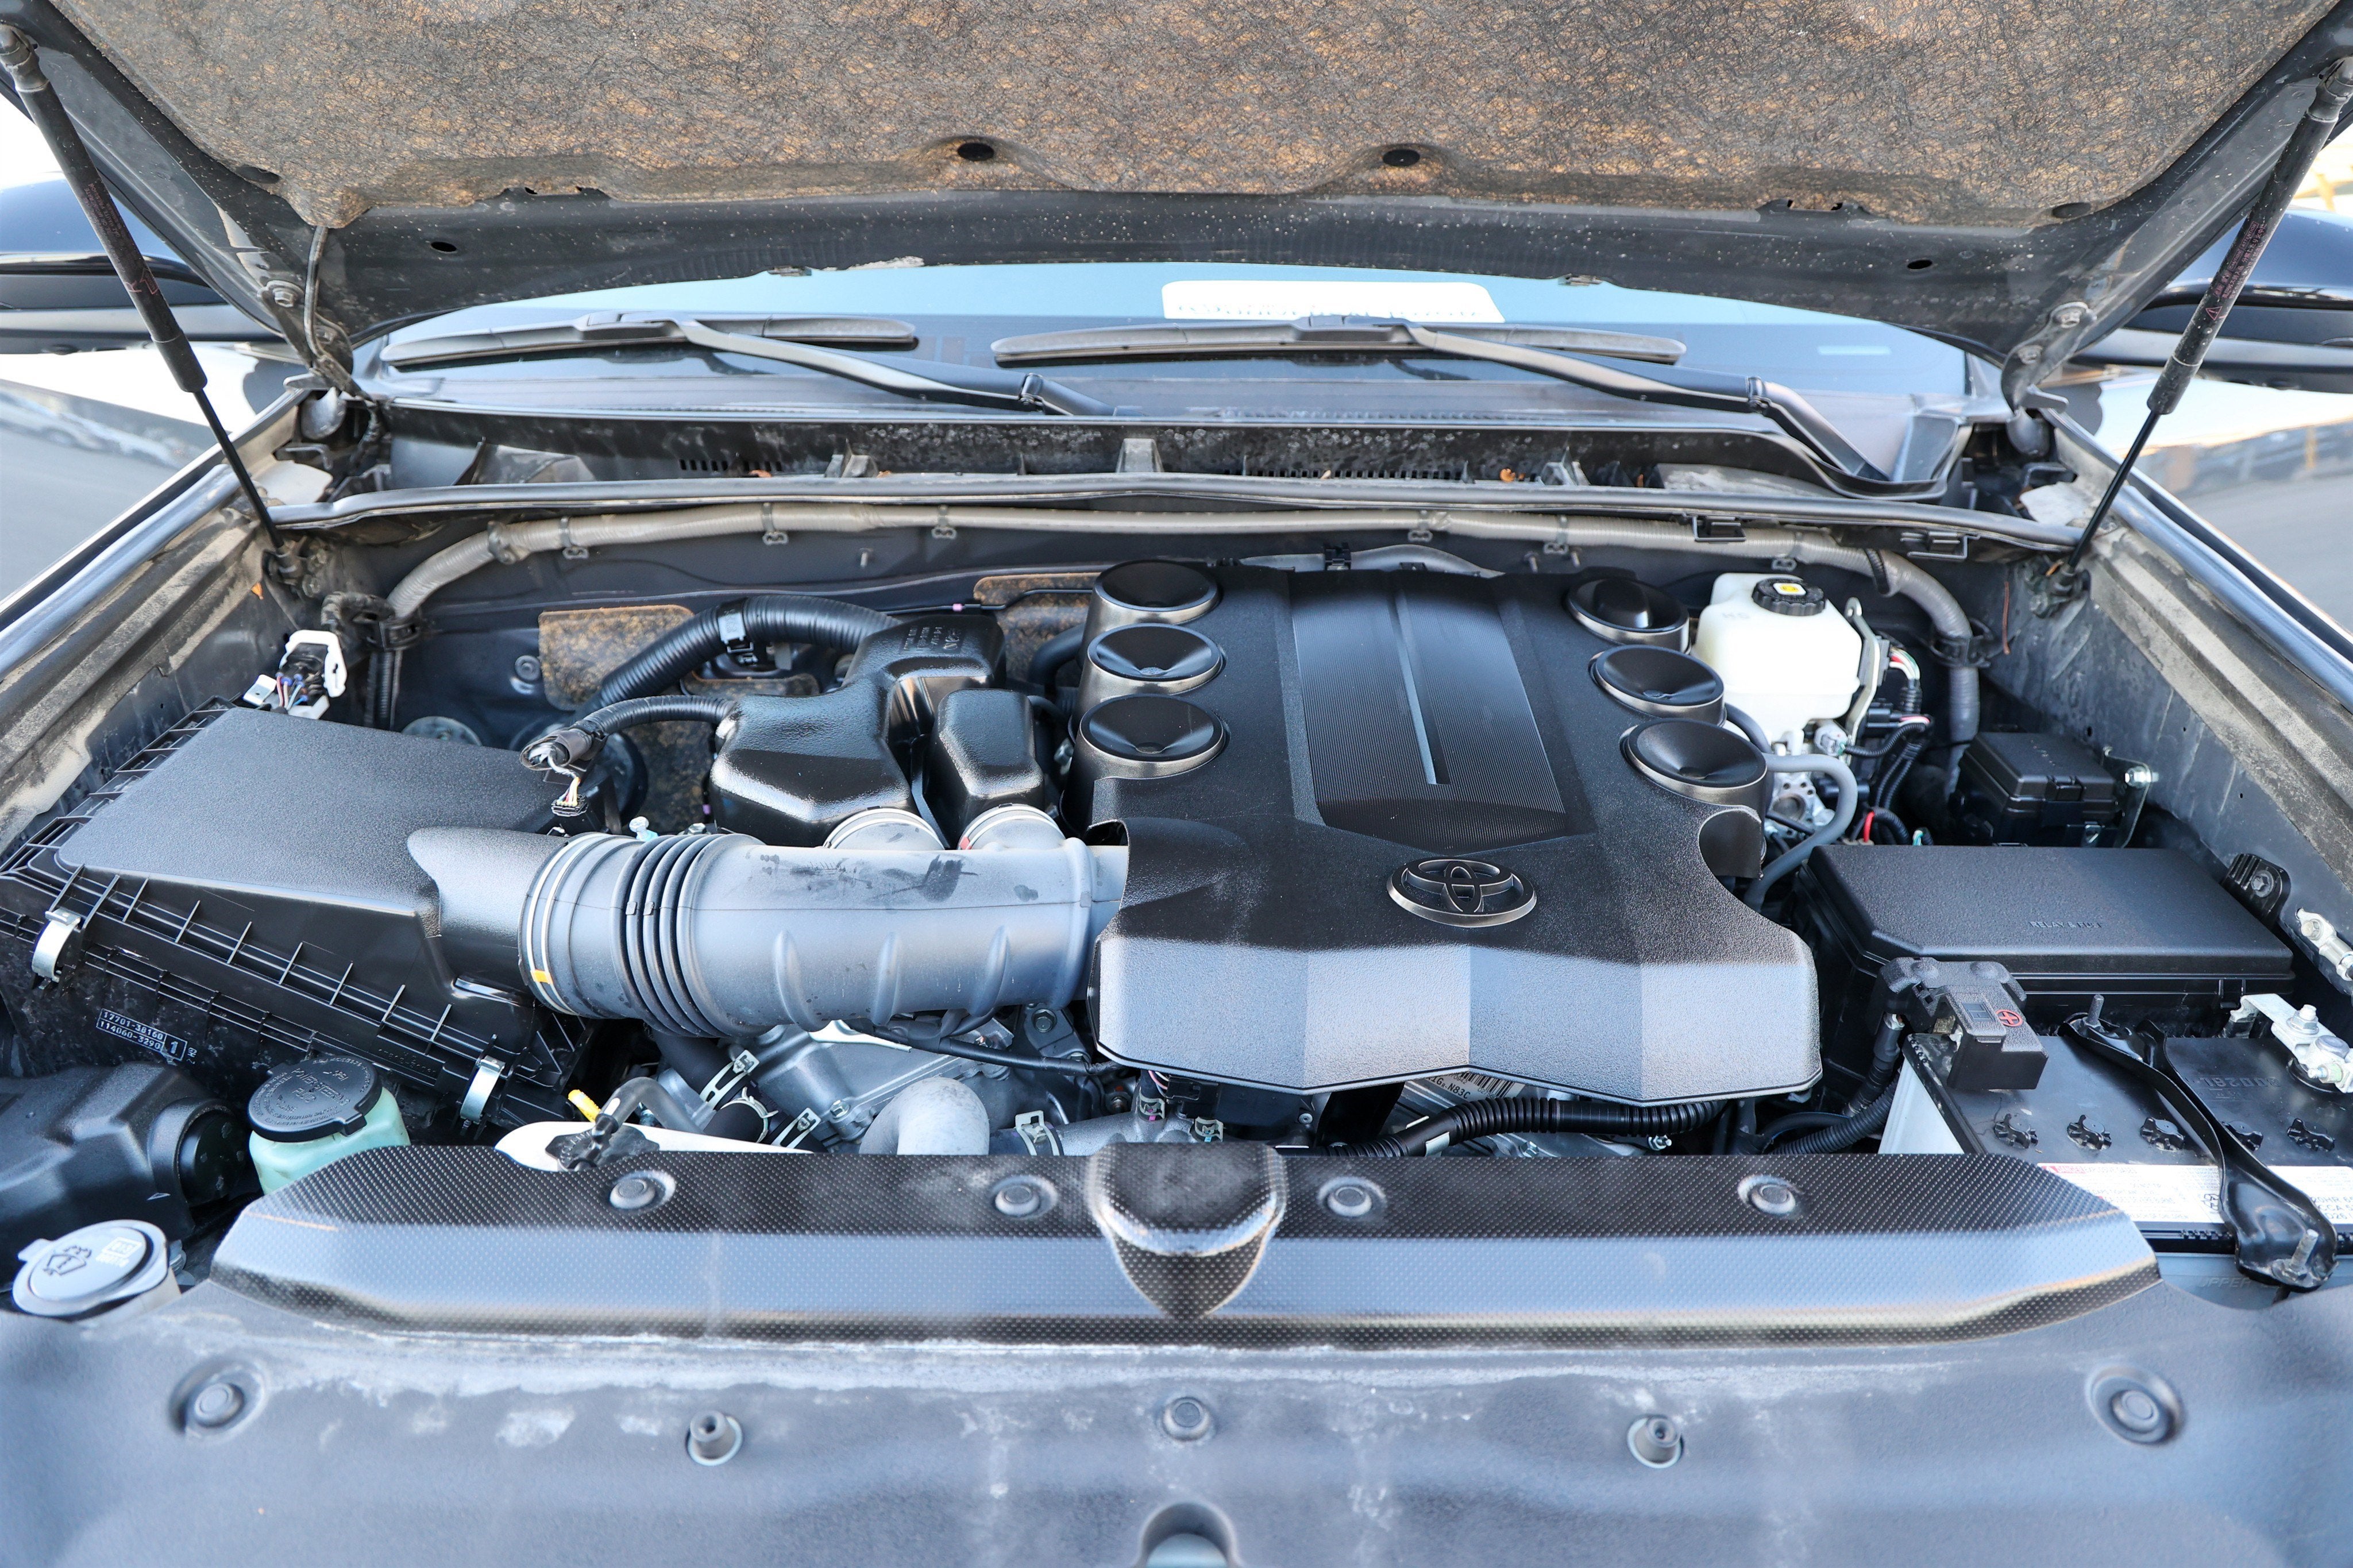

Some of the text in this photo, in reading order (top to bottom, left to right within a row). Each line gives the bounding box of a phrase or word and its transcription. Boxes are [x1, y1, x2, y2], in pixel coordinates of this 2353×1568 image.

[100, 1021, 161, 1049] 114060-3290
[103, 1011, 164, 1040] 17701-38160
[171, 1041, 179, 1054] 1
